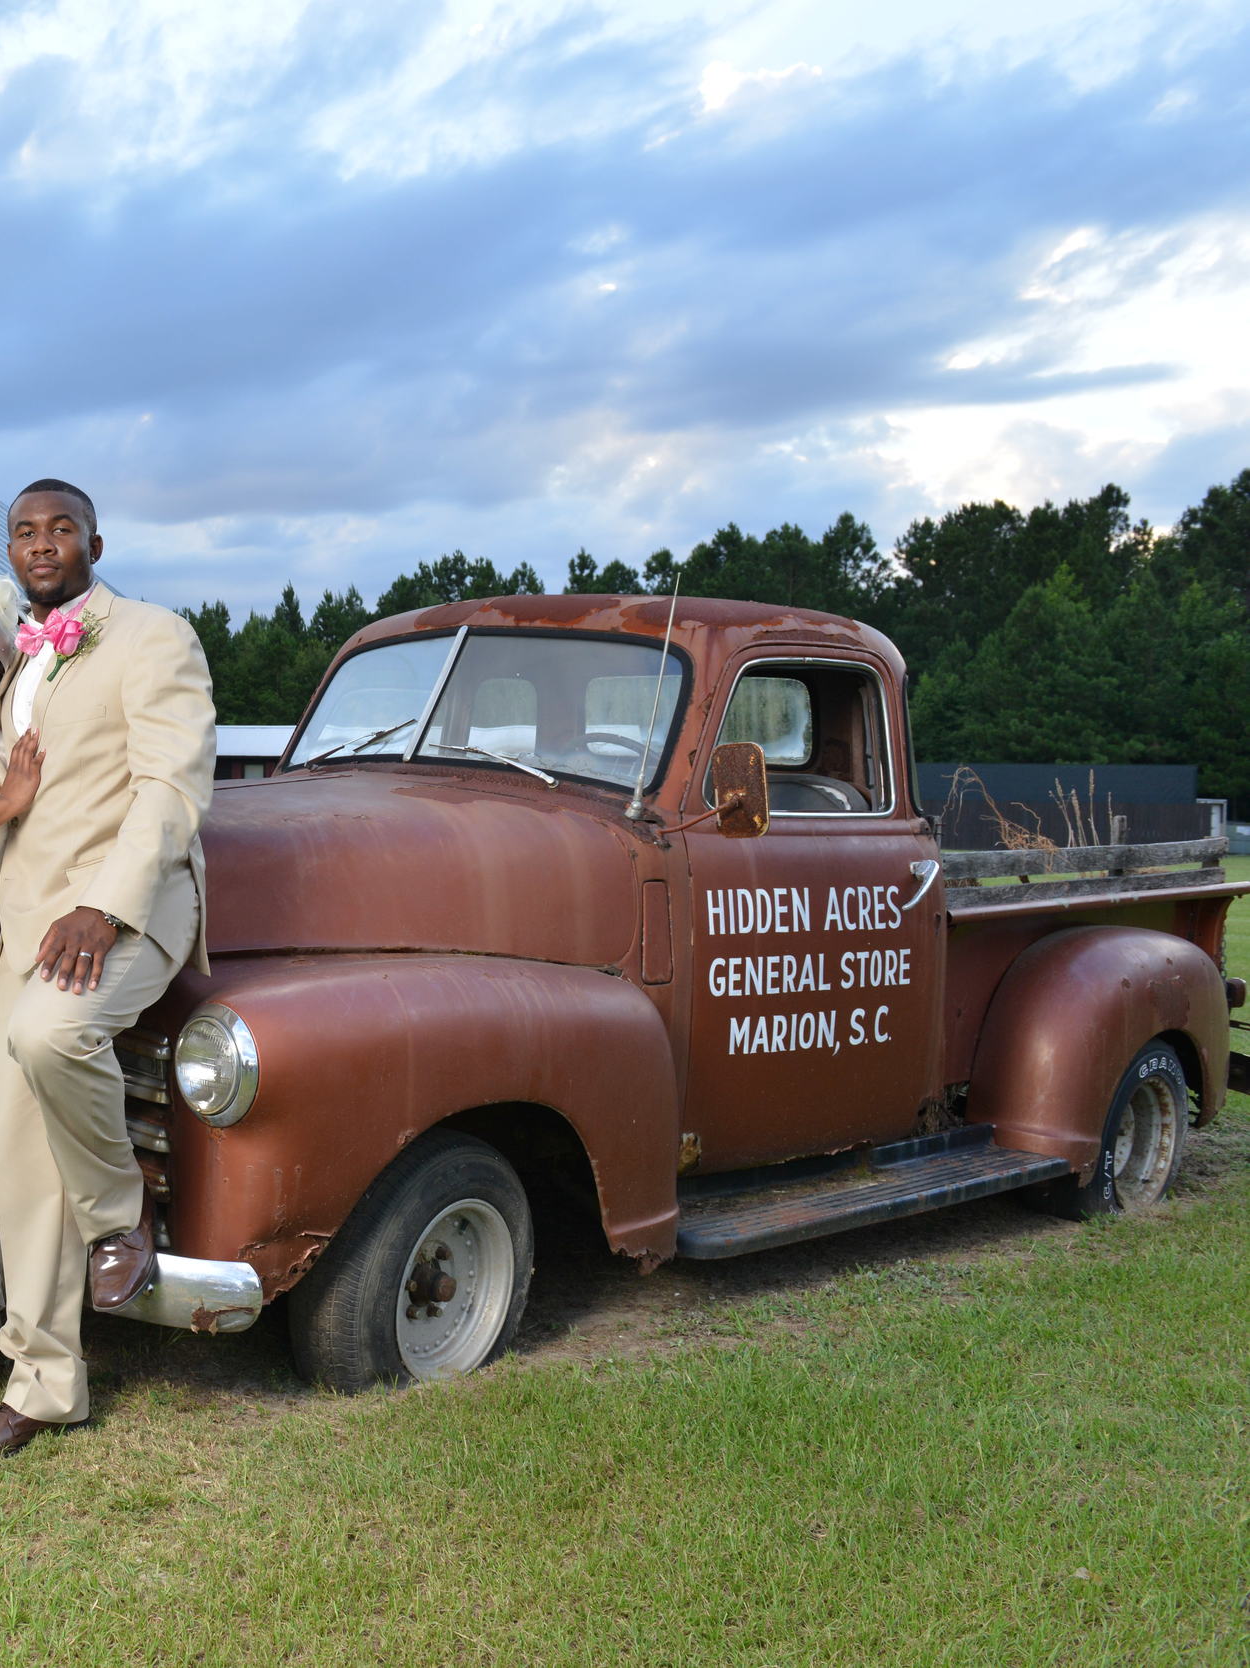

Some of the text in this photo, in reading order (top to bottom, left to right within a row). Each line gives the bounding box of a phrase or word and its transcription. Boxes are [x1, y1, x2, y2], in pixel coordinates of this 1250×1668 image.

[706, 885, 902, 935] HIDDEN ACRES
[708, 949, 911, 997] GENERAL STORE
[728, 1010, 841, 1057] MARION,
